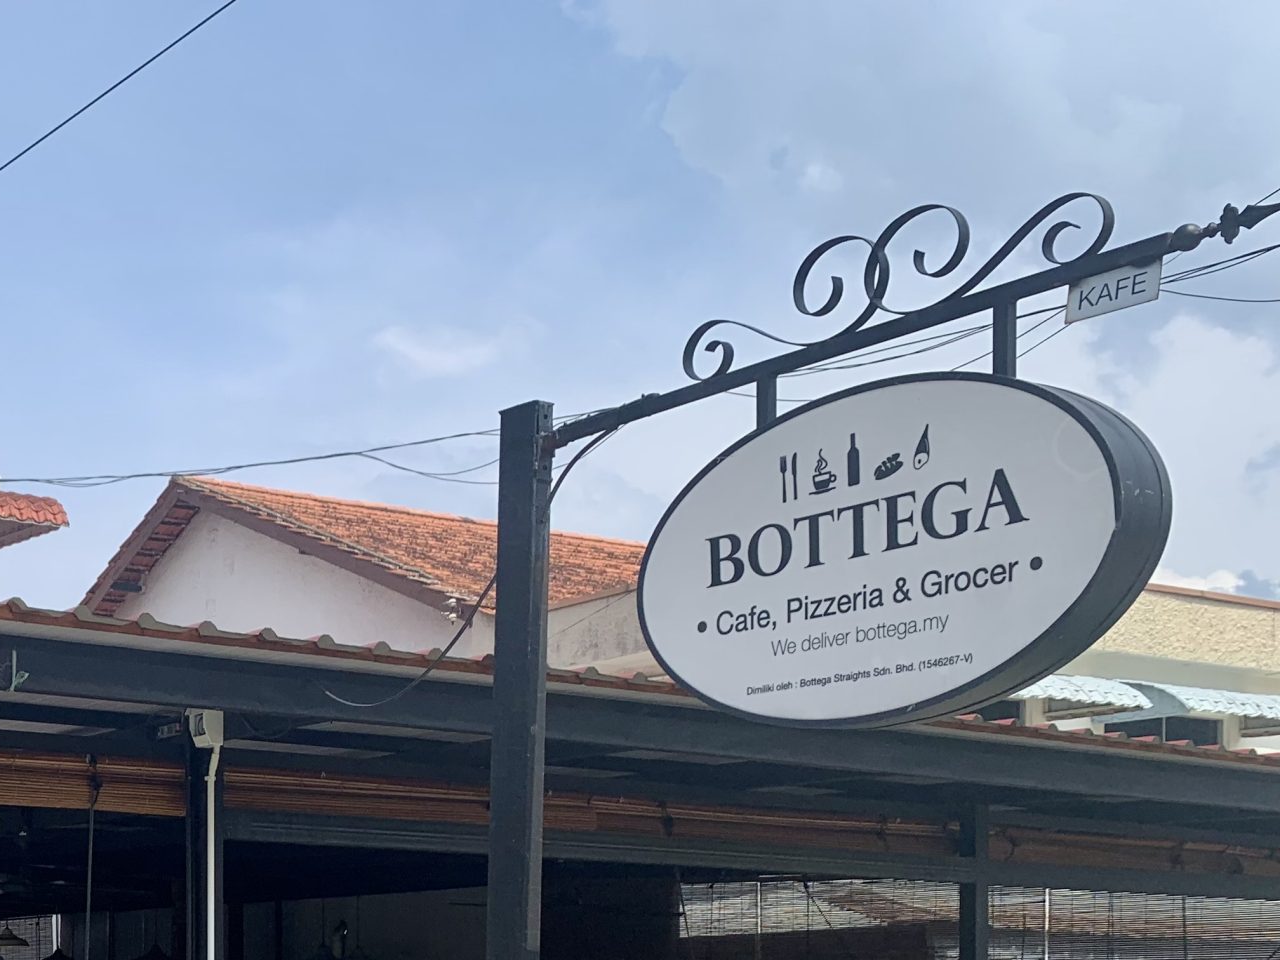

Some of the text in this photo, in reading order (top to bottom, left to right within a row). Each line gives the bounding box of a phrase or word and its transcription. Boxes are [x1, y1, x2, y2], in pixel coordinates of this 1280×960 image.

[1078, 271, 1148, 311] KAFE
[704, 468, 1030, 589] BOTTEGA
[715, 558, 1020, 637] Cafe, Pizzeria & Grocer
[771, 614, 949, 658] We deliver bottega.my
[799, 675, 832, 689] Bottega
[834, 669, 871, 684] Straights
[895, 662, 917, 674] Bhd.
[918, 652, 973, 673] (1546267-V)
